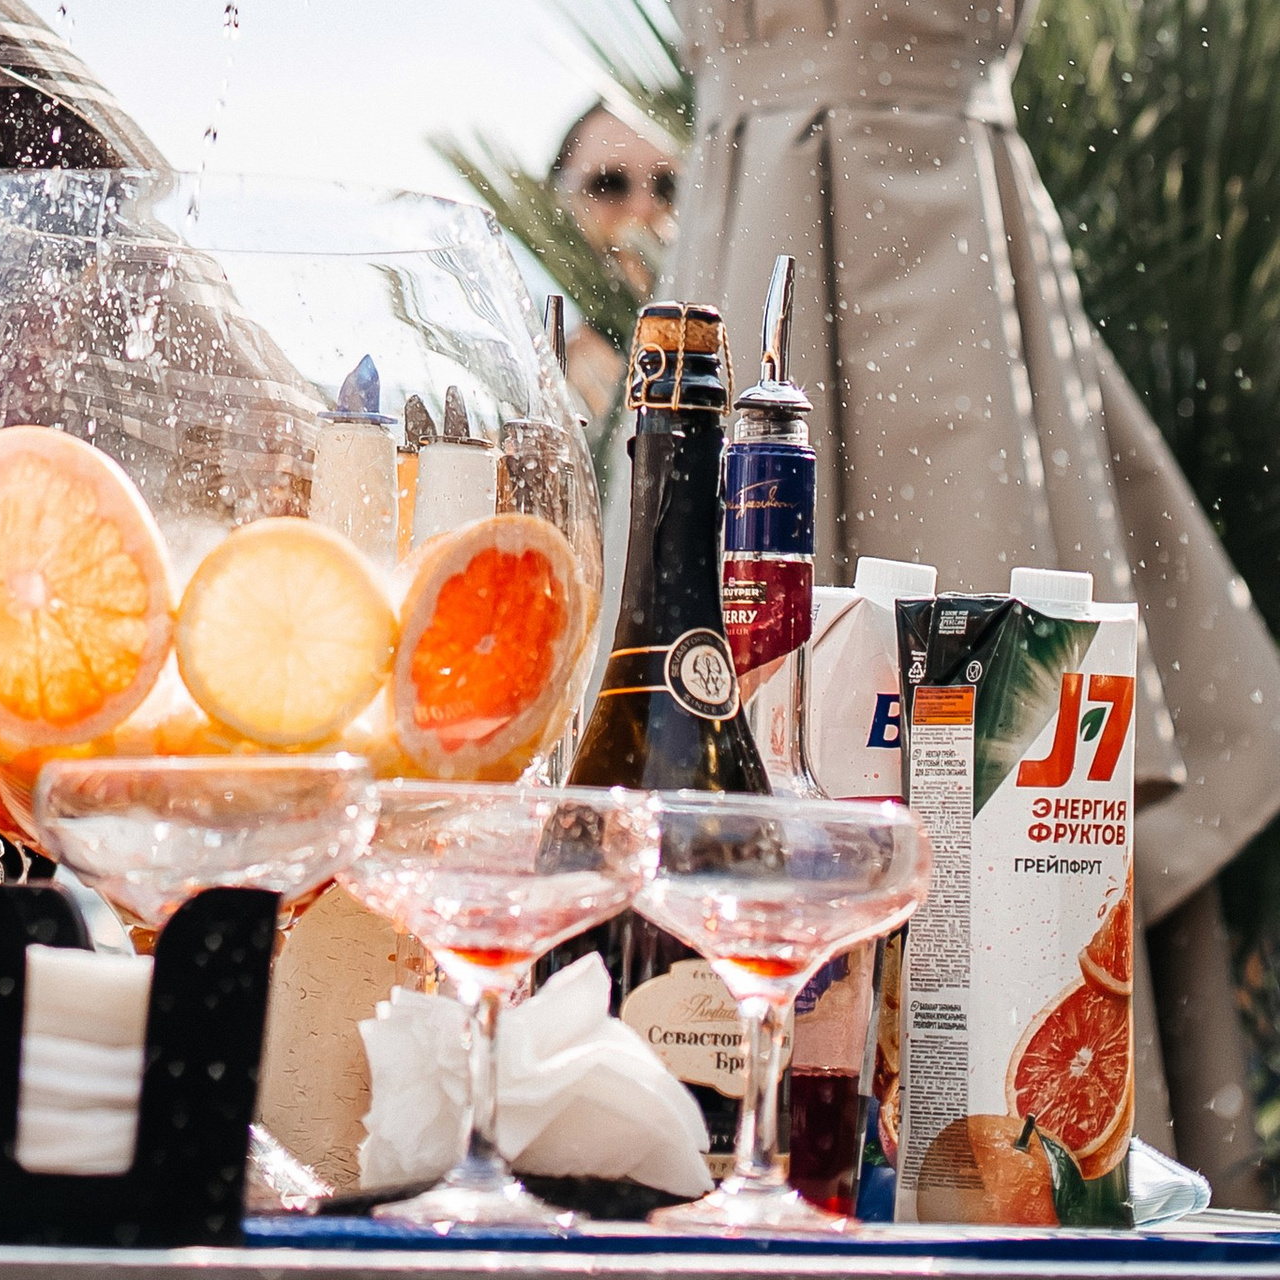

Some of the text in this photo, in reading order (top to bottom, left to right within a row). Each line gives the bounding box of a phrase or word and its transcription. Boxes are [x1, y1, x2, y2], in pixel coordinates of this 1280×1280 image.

[723, 610, 758, 624] ERRY
[1016, 672, 1134, 788] J7
[1031, 798, 1127, 822] ЭНЕРГИЯ
[1028, 822, 1127, 846] ФРУКТОВ
[1014, 854, 1102, 875] ГРЕЙПФРУТ
